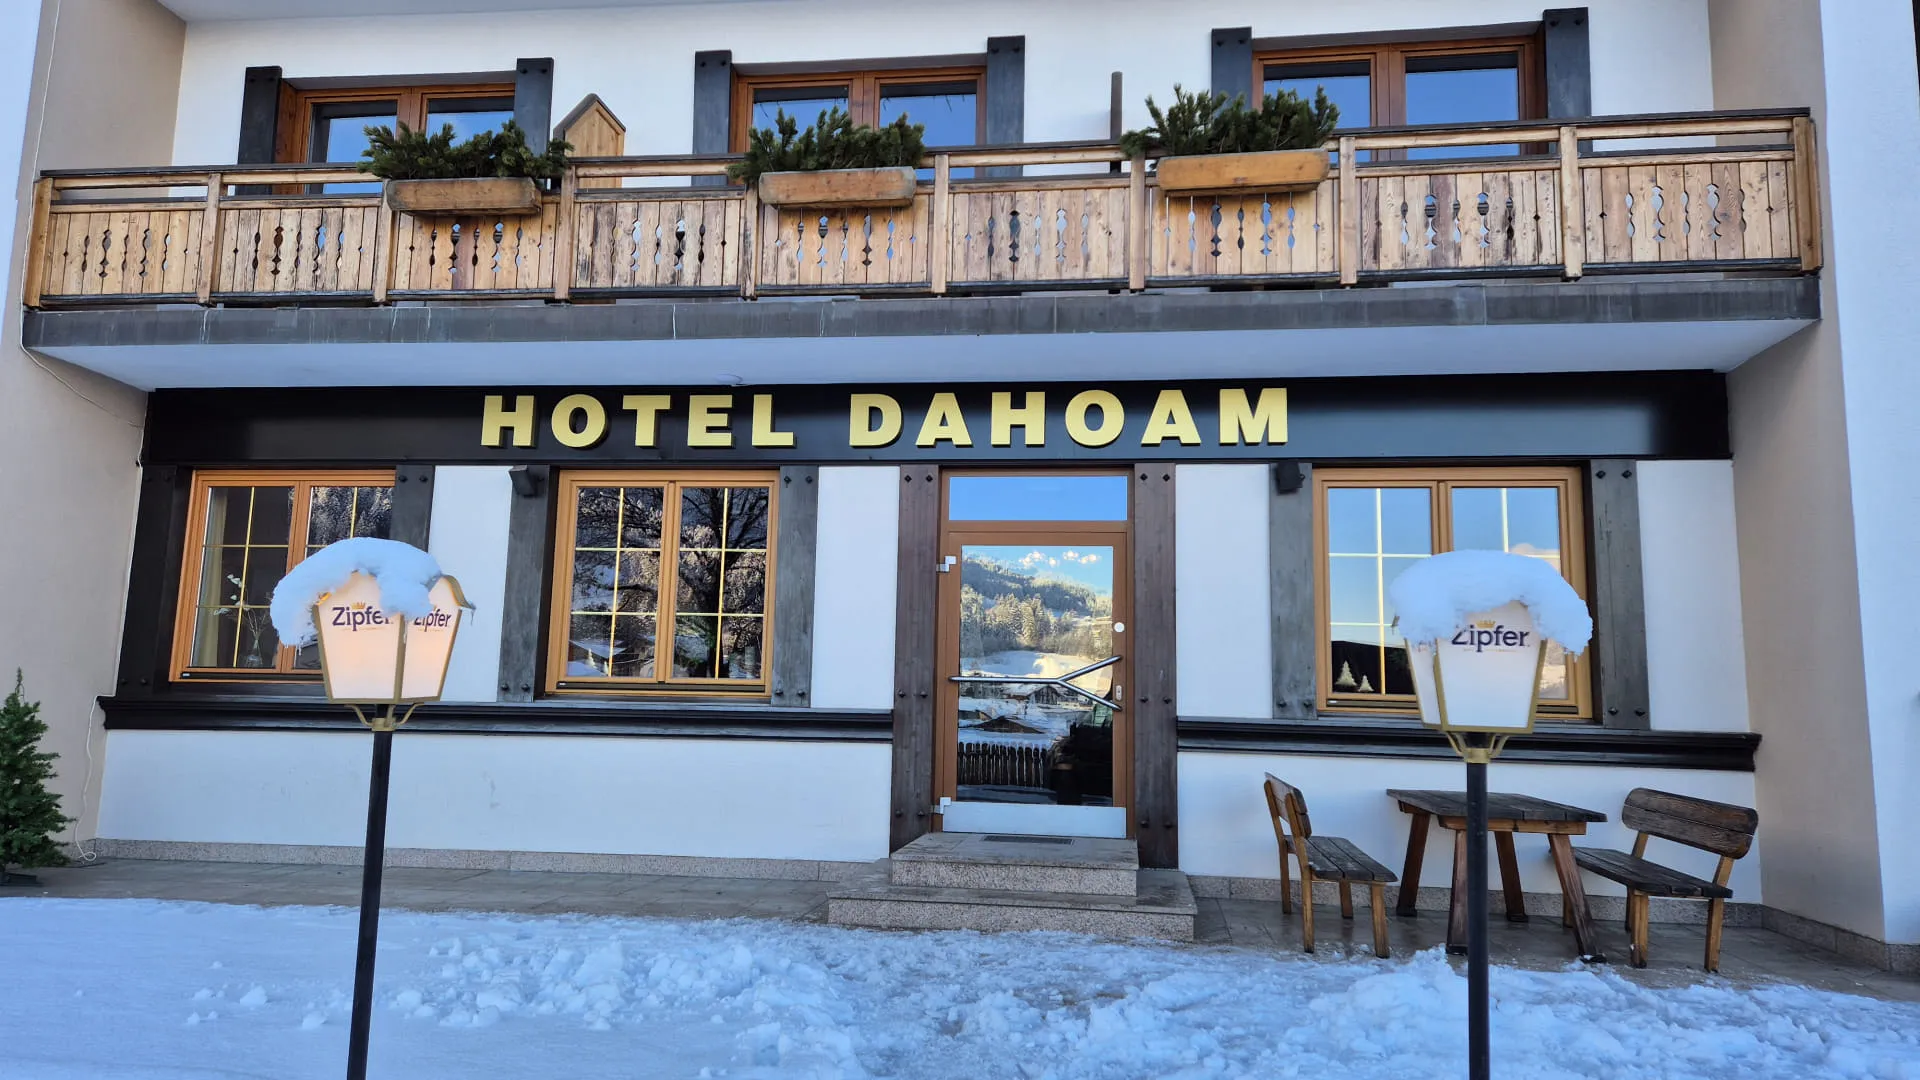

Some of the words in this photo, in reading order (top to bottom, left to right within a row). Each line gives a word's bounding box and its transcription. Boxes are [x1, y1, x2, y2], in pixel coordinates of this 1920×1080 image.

[481, 394, 795, 448] HOTEL
[849, 388, 1288, 447] DAHOAM
[1452, 624, 1530, 652] Zipfer
